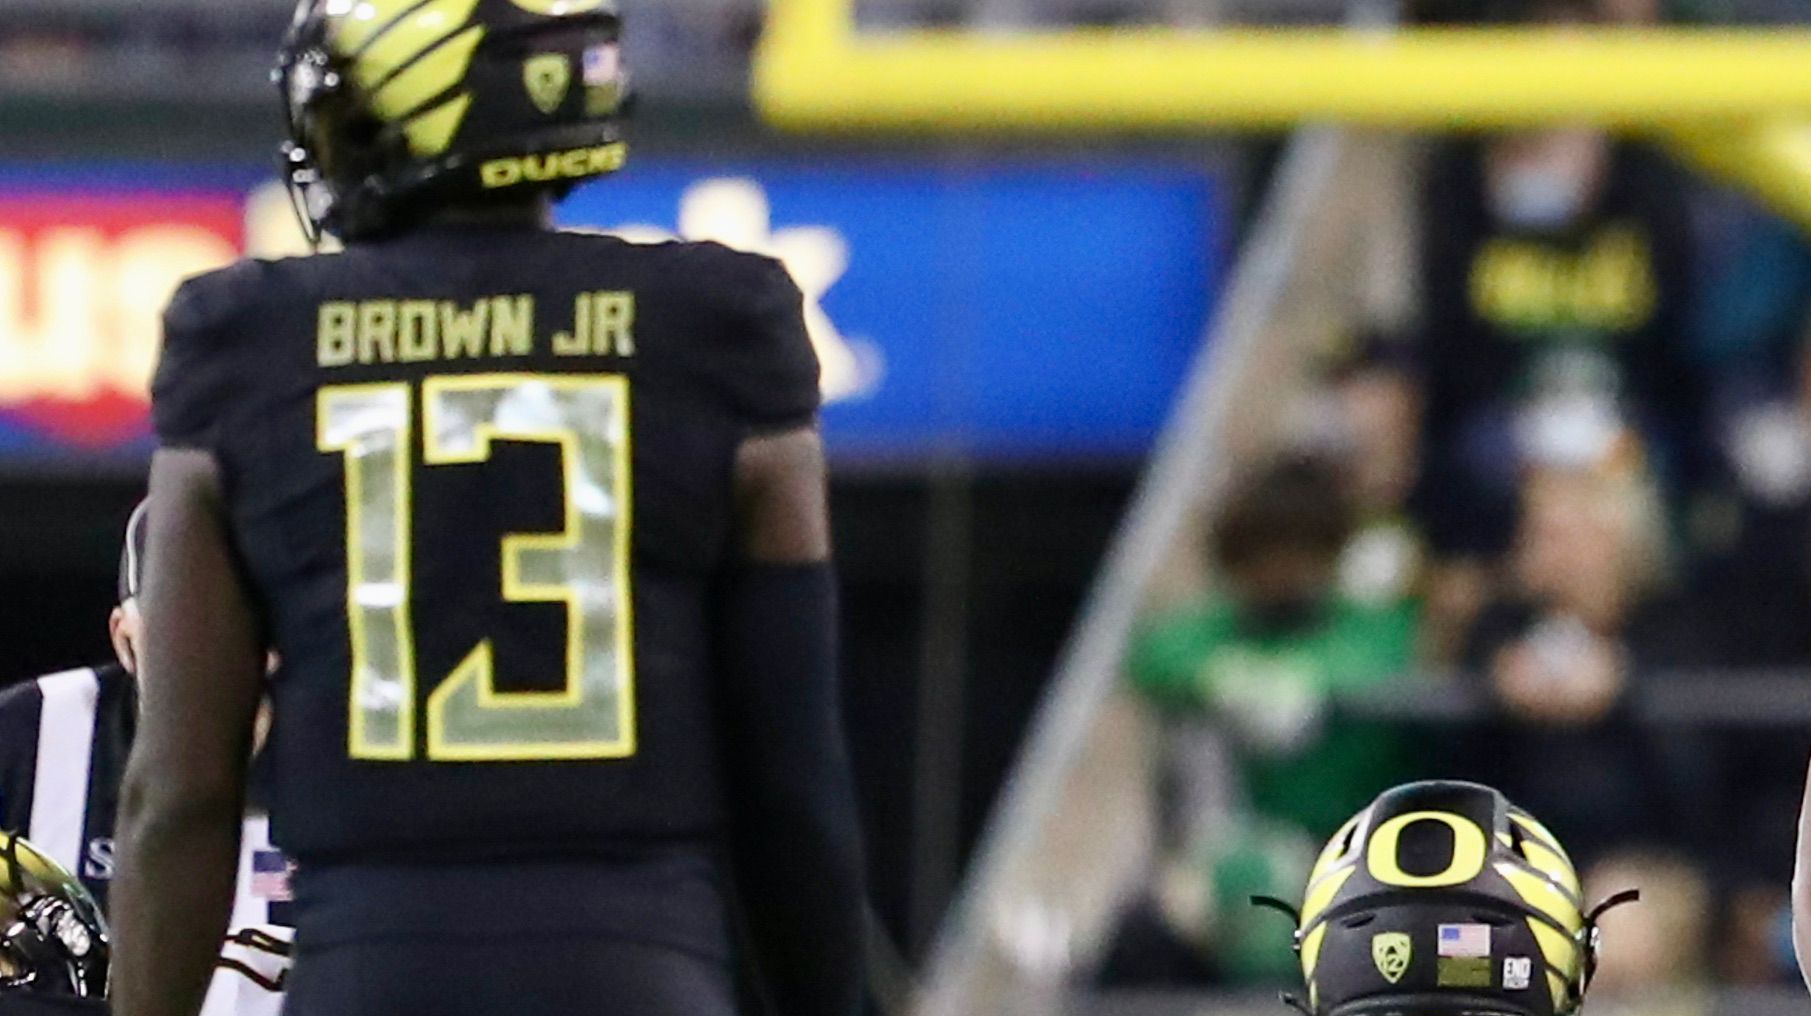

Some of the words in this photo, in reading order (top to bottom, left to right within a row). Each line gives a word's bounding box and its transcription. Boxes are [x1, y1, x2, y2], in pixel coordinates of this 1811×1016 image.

[316, 293, 534, 367] BROWN
[551, 292, 636, 356] JR
[316, 373, 636, 760] 13
[1366, 810, 1486, 887] O
